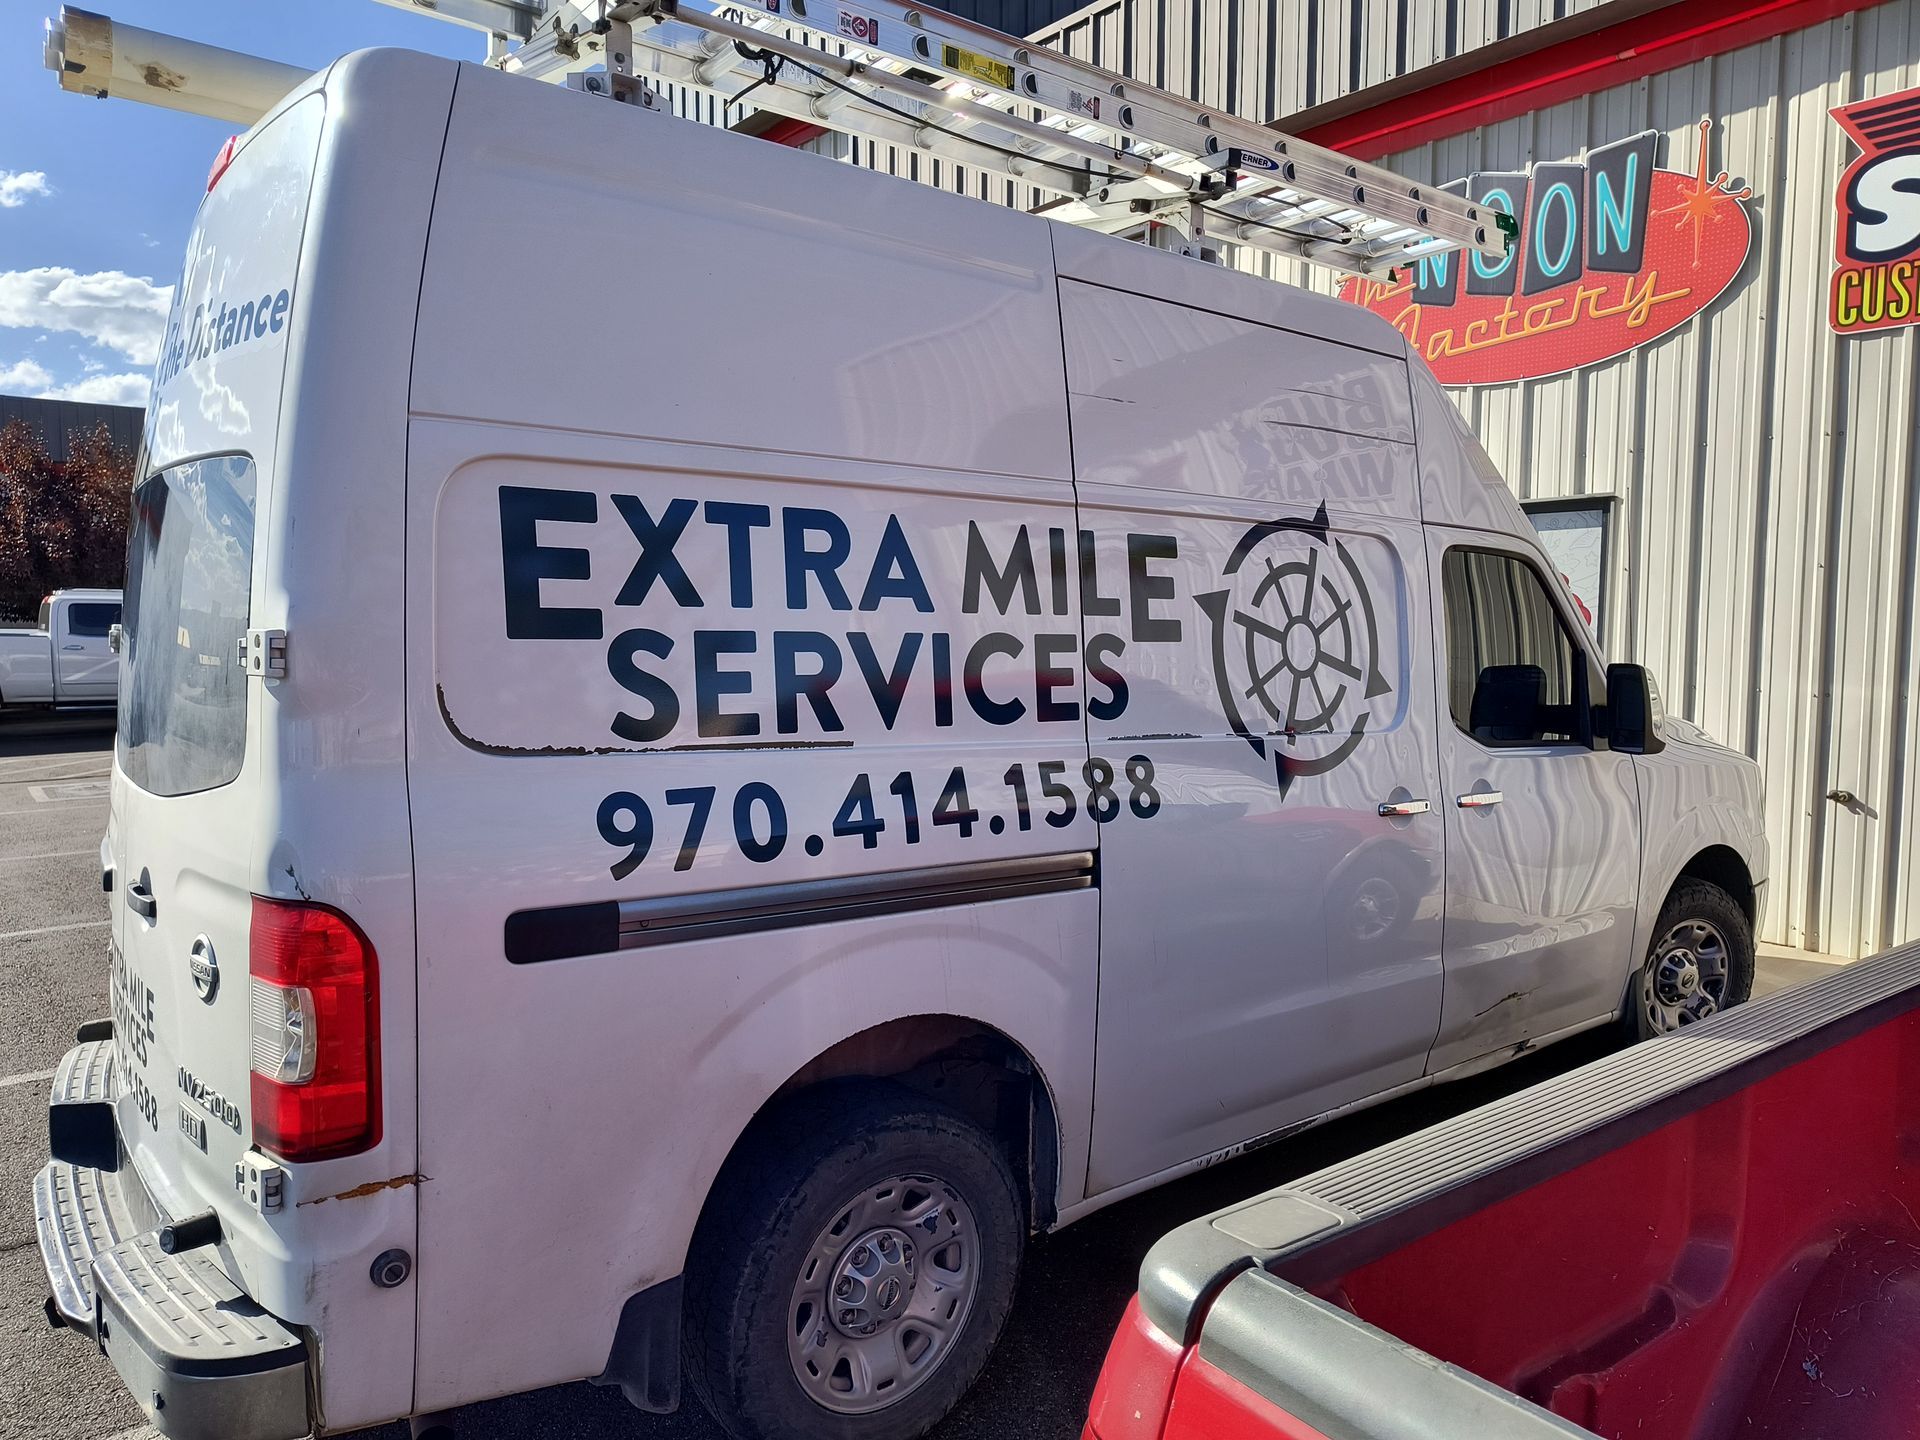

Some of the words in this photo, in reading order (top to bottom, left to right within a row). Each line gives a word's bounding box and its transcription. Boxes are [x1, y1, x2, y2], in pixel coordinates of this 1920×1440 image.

[1240, 152, 1269, 167] ERNER
[184, 289, 290, 369] Distance
[499, 485, 935, 640] EXTRA
[961, 519, 1182, 643] MILE
[606, 627, 1130, 743] SERVICES
[596, 754, 1161, 882] 970.414.1588
[129, 967, 155, 1044] MILE
[181, 1110, 198, 1140] HD
